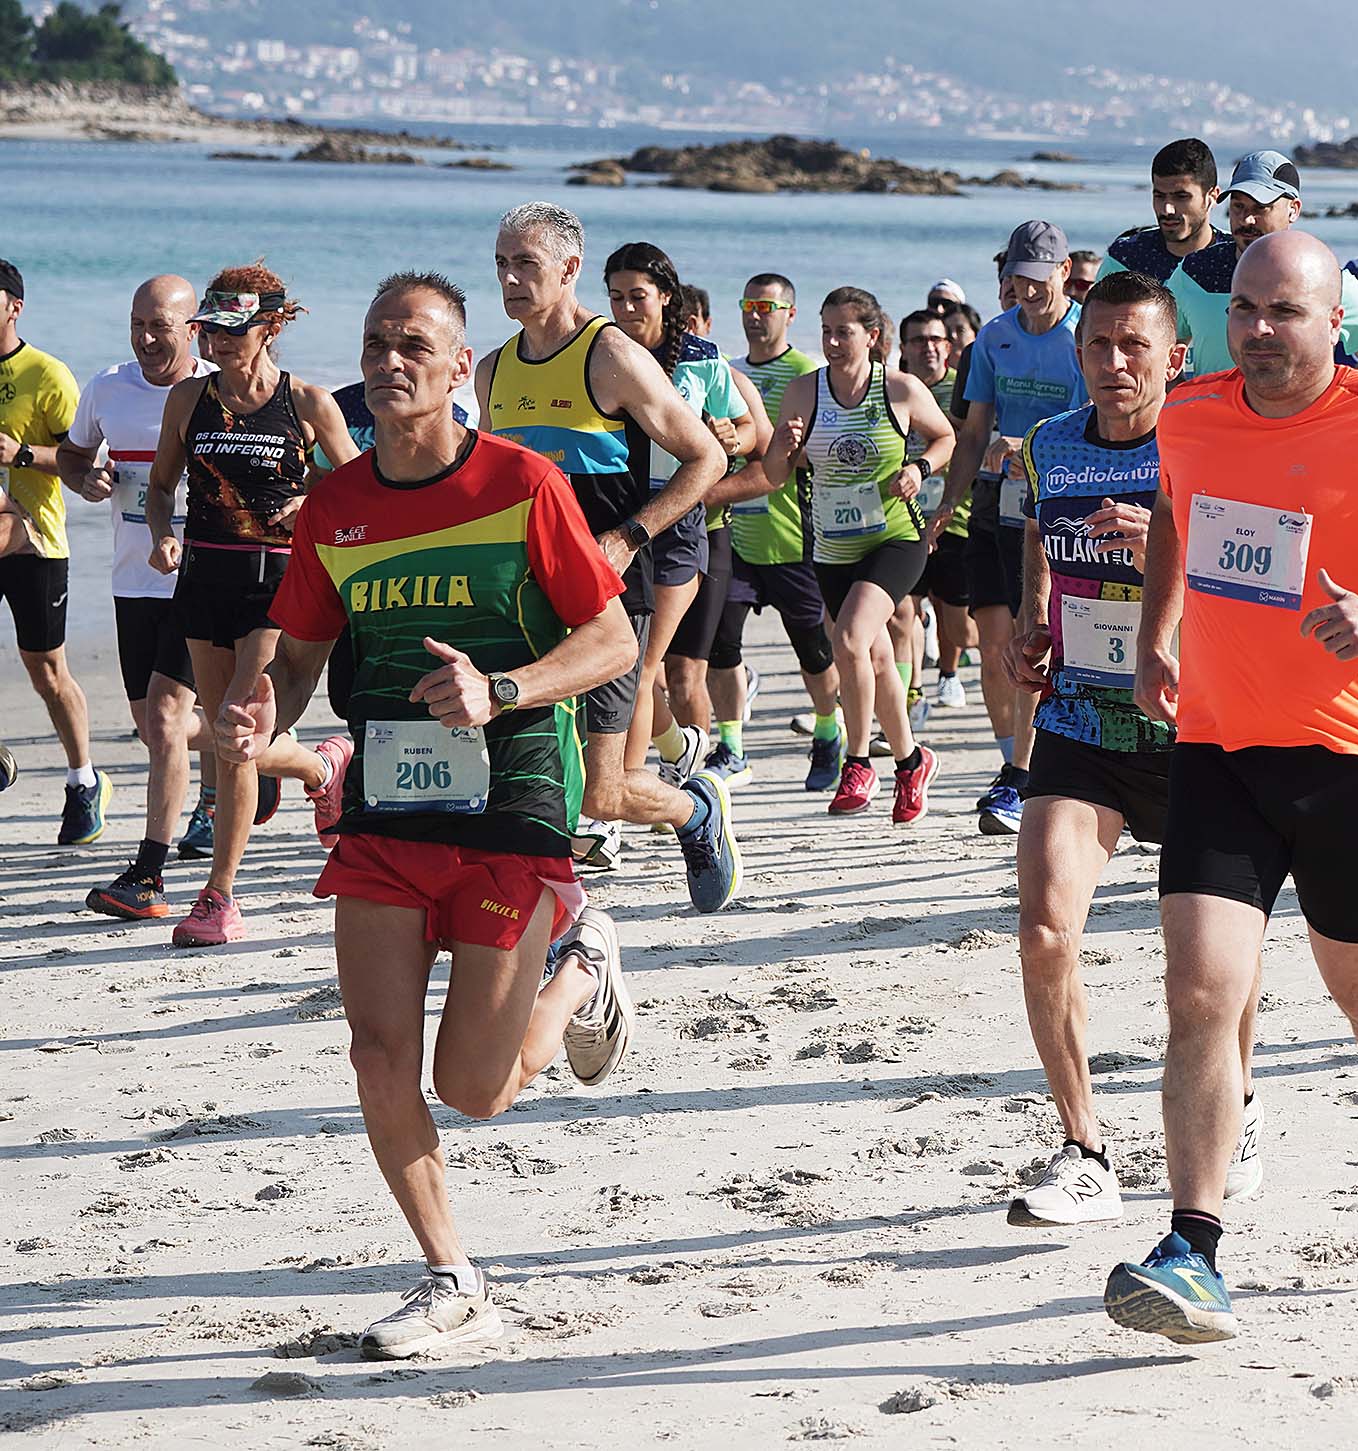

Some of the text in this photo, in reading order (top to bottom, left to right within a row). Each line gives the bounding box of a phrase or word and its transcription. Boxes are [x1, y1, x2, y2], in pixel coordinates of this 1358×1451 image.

[195, 431, 286, 445] OS CORREDORES
[194, 443, 286, 459] DO INFERNO
[834, 507, 862, 524] 270
[1236, 527, 1256, 537] ELOY
[1218, 540, 1272, 576] 309
[351, 575, 475, 613] BIKILA
[1093, 623, 1133, 632] GIOVANNI
[1108, 637, 1125, 664] 3
[404, 747, 433, 755] RUBEN
[396, 761, 452, 790] 206
[480, 899, 520, 920] BIKILA
